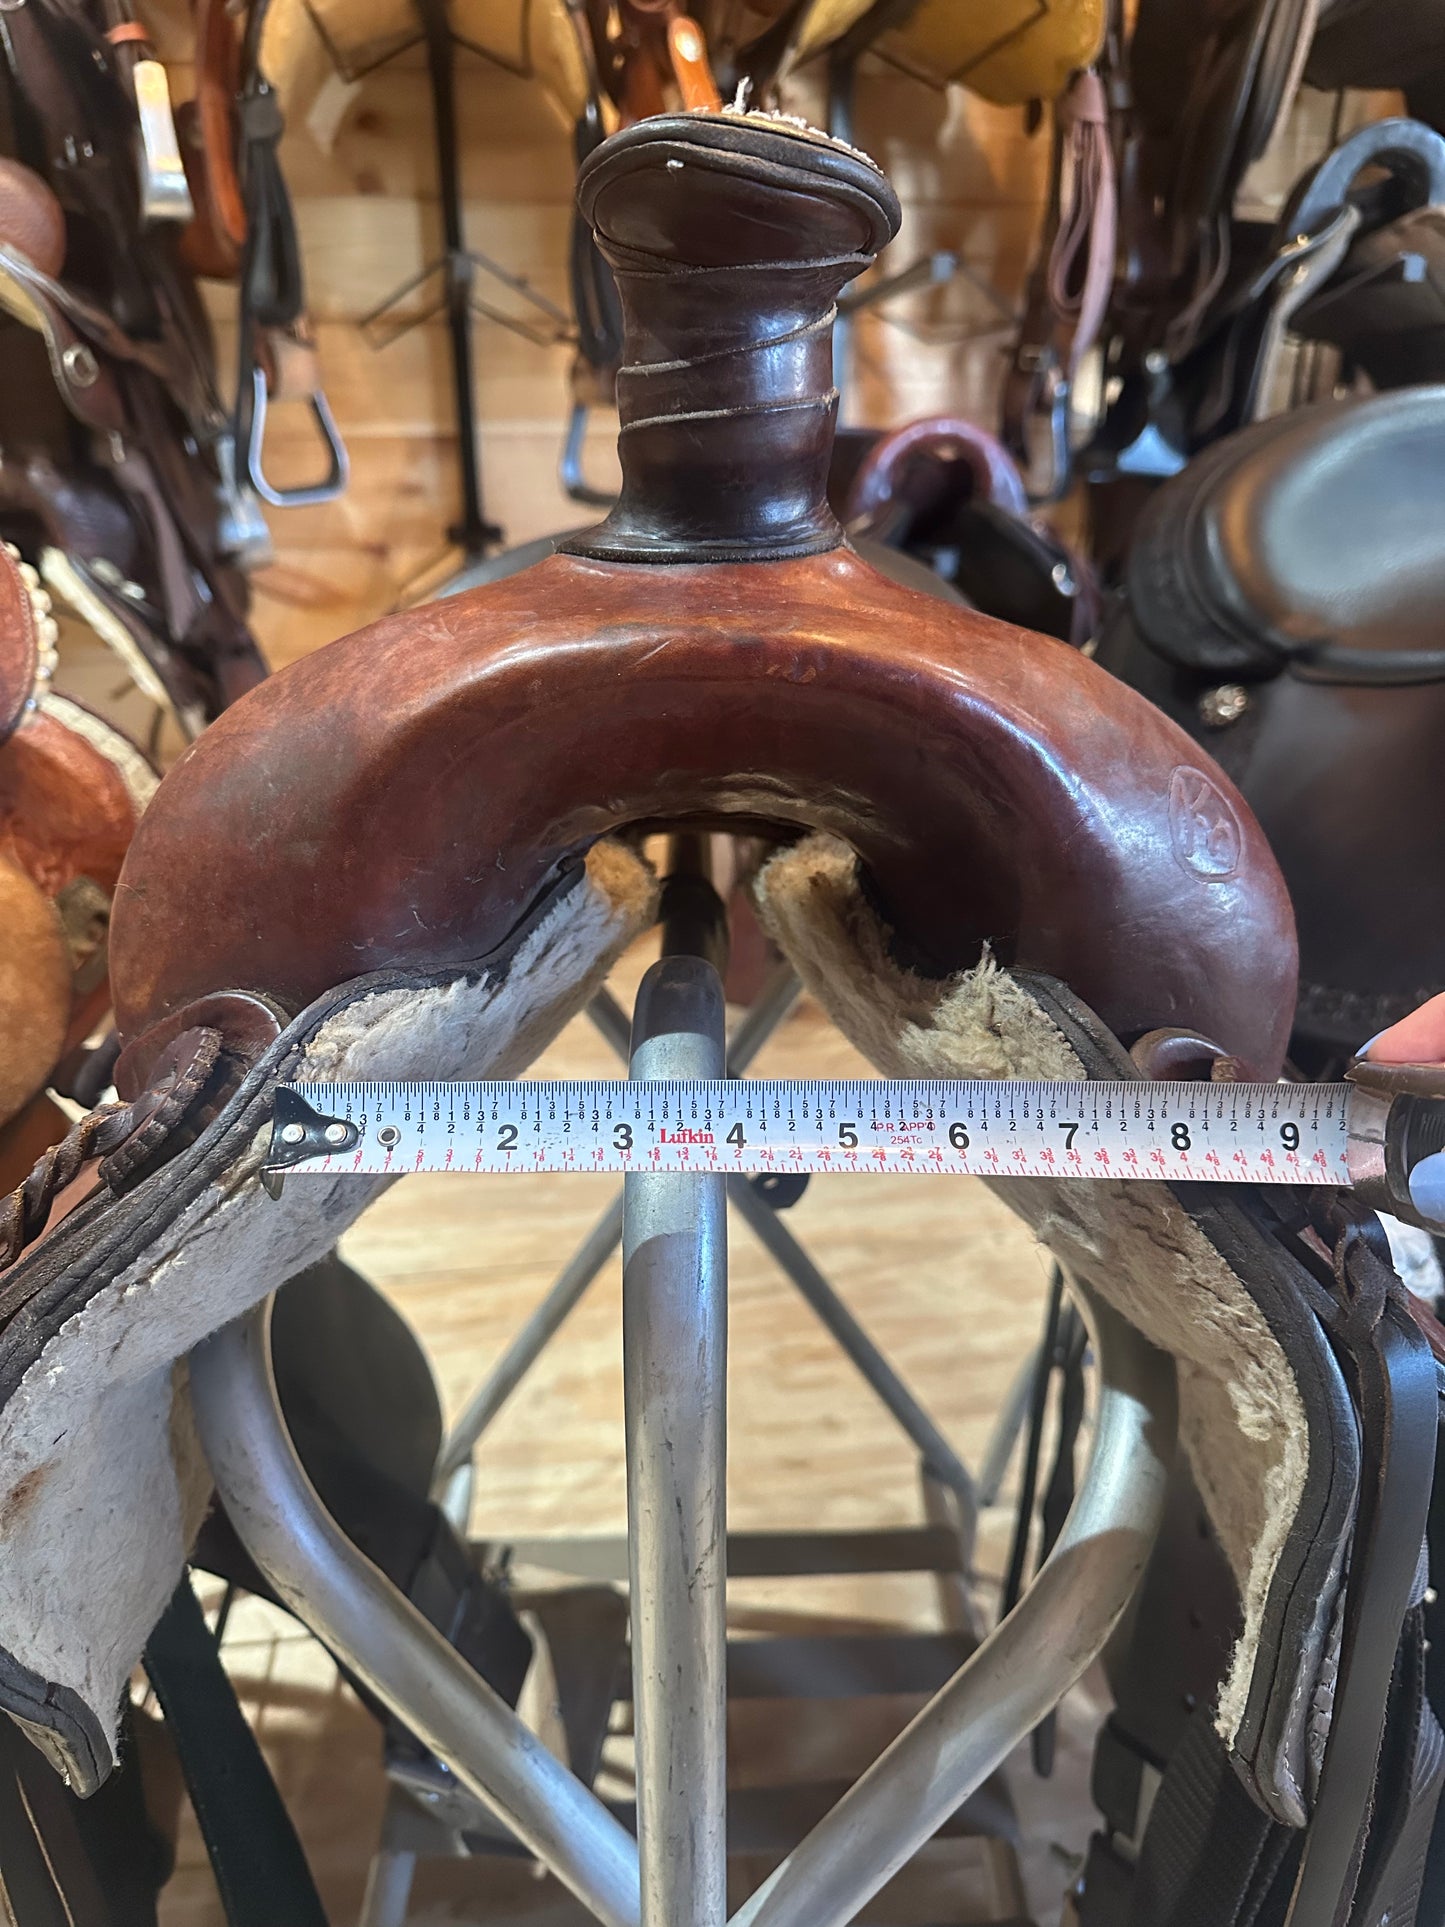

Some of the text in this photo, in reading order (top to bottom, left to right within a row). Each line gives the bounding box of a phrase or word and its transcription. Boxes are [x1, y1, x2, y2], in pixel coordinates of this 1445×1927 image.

[496, 1122, 1299, 1151] 2 3 4 5 6 7 8 9
[660, 1128, 714, 1144] Lufkin
[890, 1136, 923, 1144] 254Tc
